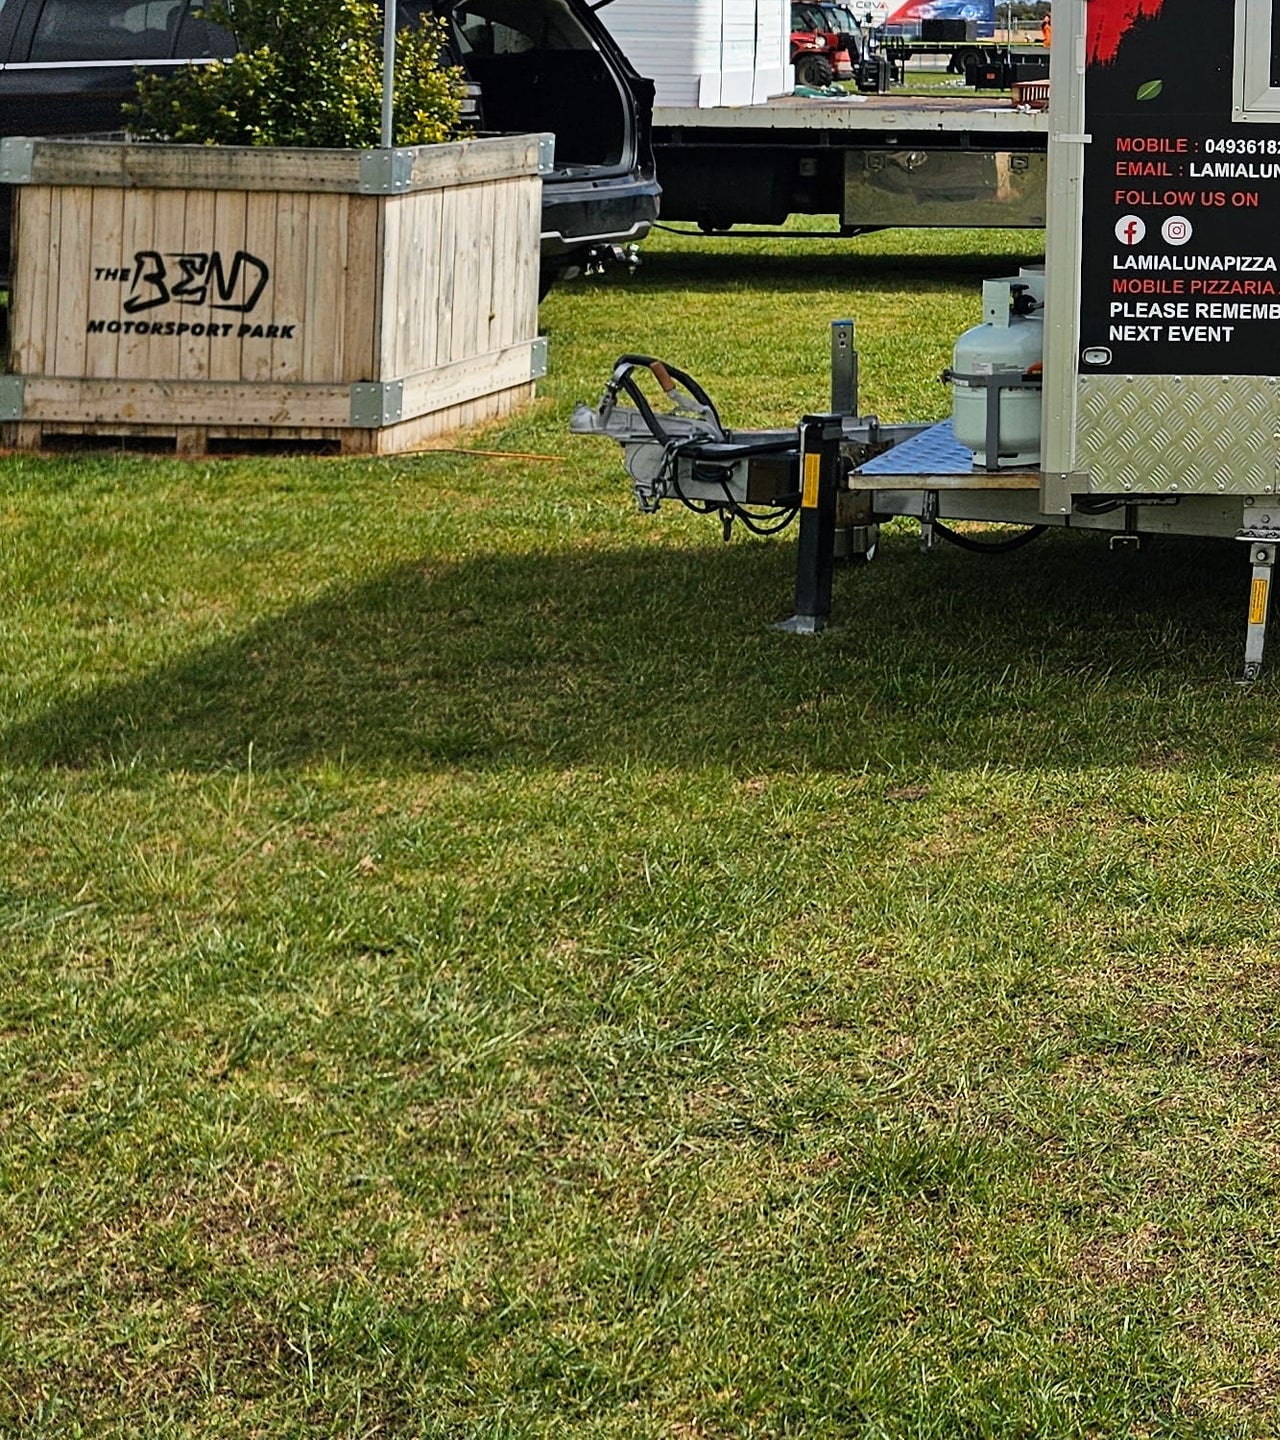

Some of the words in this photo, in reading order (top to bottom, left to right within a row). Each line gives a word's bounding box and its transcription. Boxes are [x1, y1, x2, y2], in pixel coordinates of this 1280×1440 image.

[1115, 137, 1188, 153] MOBILE
[1115, 161, 1173, 177] EMAIL
[1114, 189, 1196, 207] FOLLOW
[1200, 191, 1226, 207] US
[1231, 191, 1259, 207] ON
[1112, 254, 1277, 272] LAMIALUNAPIZZA
[95, 268, 131, 282] THE
[123, 250, 270, 314] BEND
[1112, 278, 1185, 295] MOBILE
[1190, 279, 1276, 296] PIZZARIA
[1110, 301, 1190, 319] PLEASE
[86, 320, 233, 338] MOTORSPORT
[237, 323, 296, 339] PARK
[1109, 325, 1163, 342] NEXT
[1168, 326, 1235, 343] EVENT
